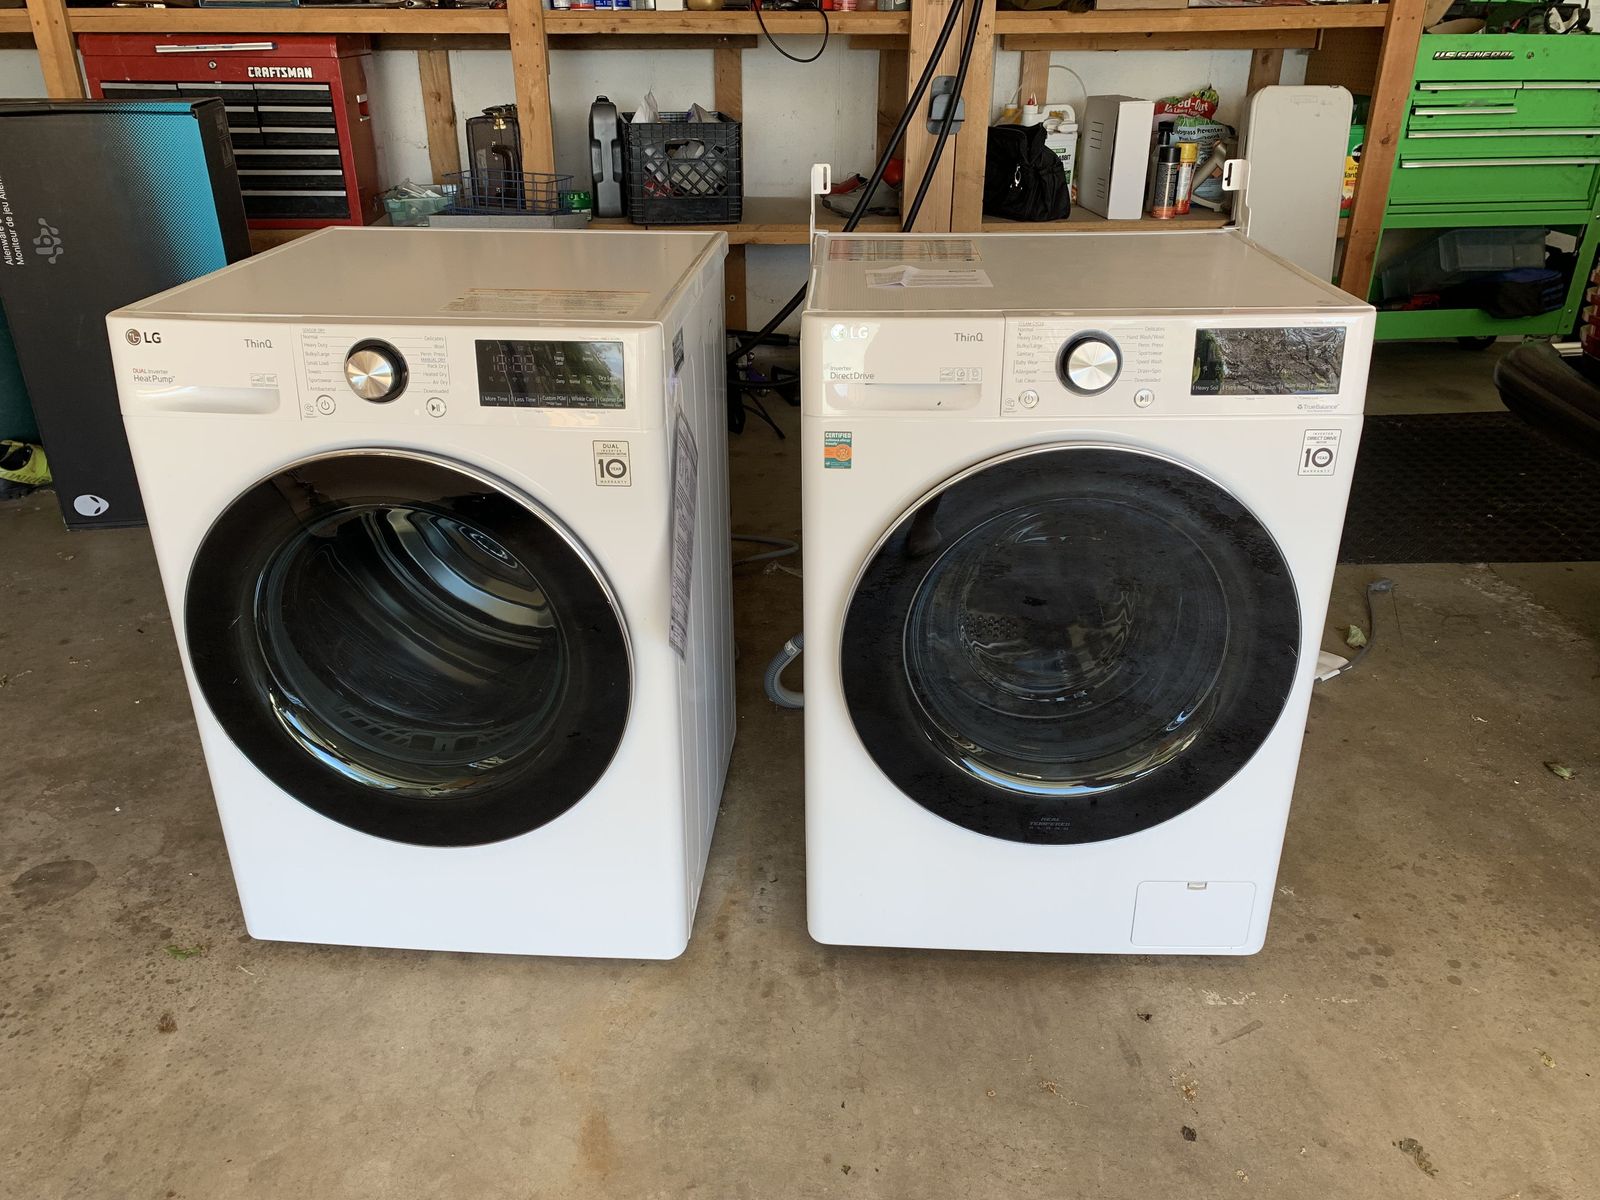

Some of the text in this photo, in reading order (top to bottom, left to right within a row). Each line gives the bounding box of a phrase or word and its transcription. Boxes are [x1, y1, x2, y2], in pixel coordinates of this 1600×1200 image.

[247, 66, 313, 78] CRAFTSMAN
[2, 202, 13, 215] jeu
[5, 216, 14, 228] de
[0, 225, 14, 265] Alienware
[9, 229, 25, 265] Moniteur
[144, 332, 162, 344] LG
[850, 326, 869, 339] LG
[954, 332, 984, 342] ThinQ
[244, 338, 273, 349] ThinQ
[1304, 447, 1334, 468] 10
[598, 458, 627, 479] 10
